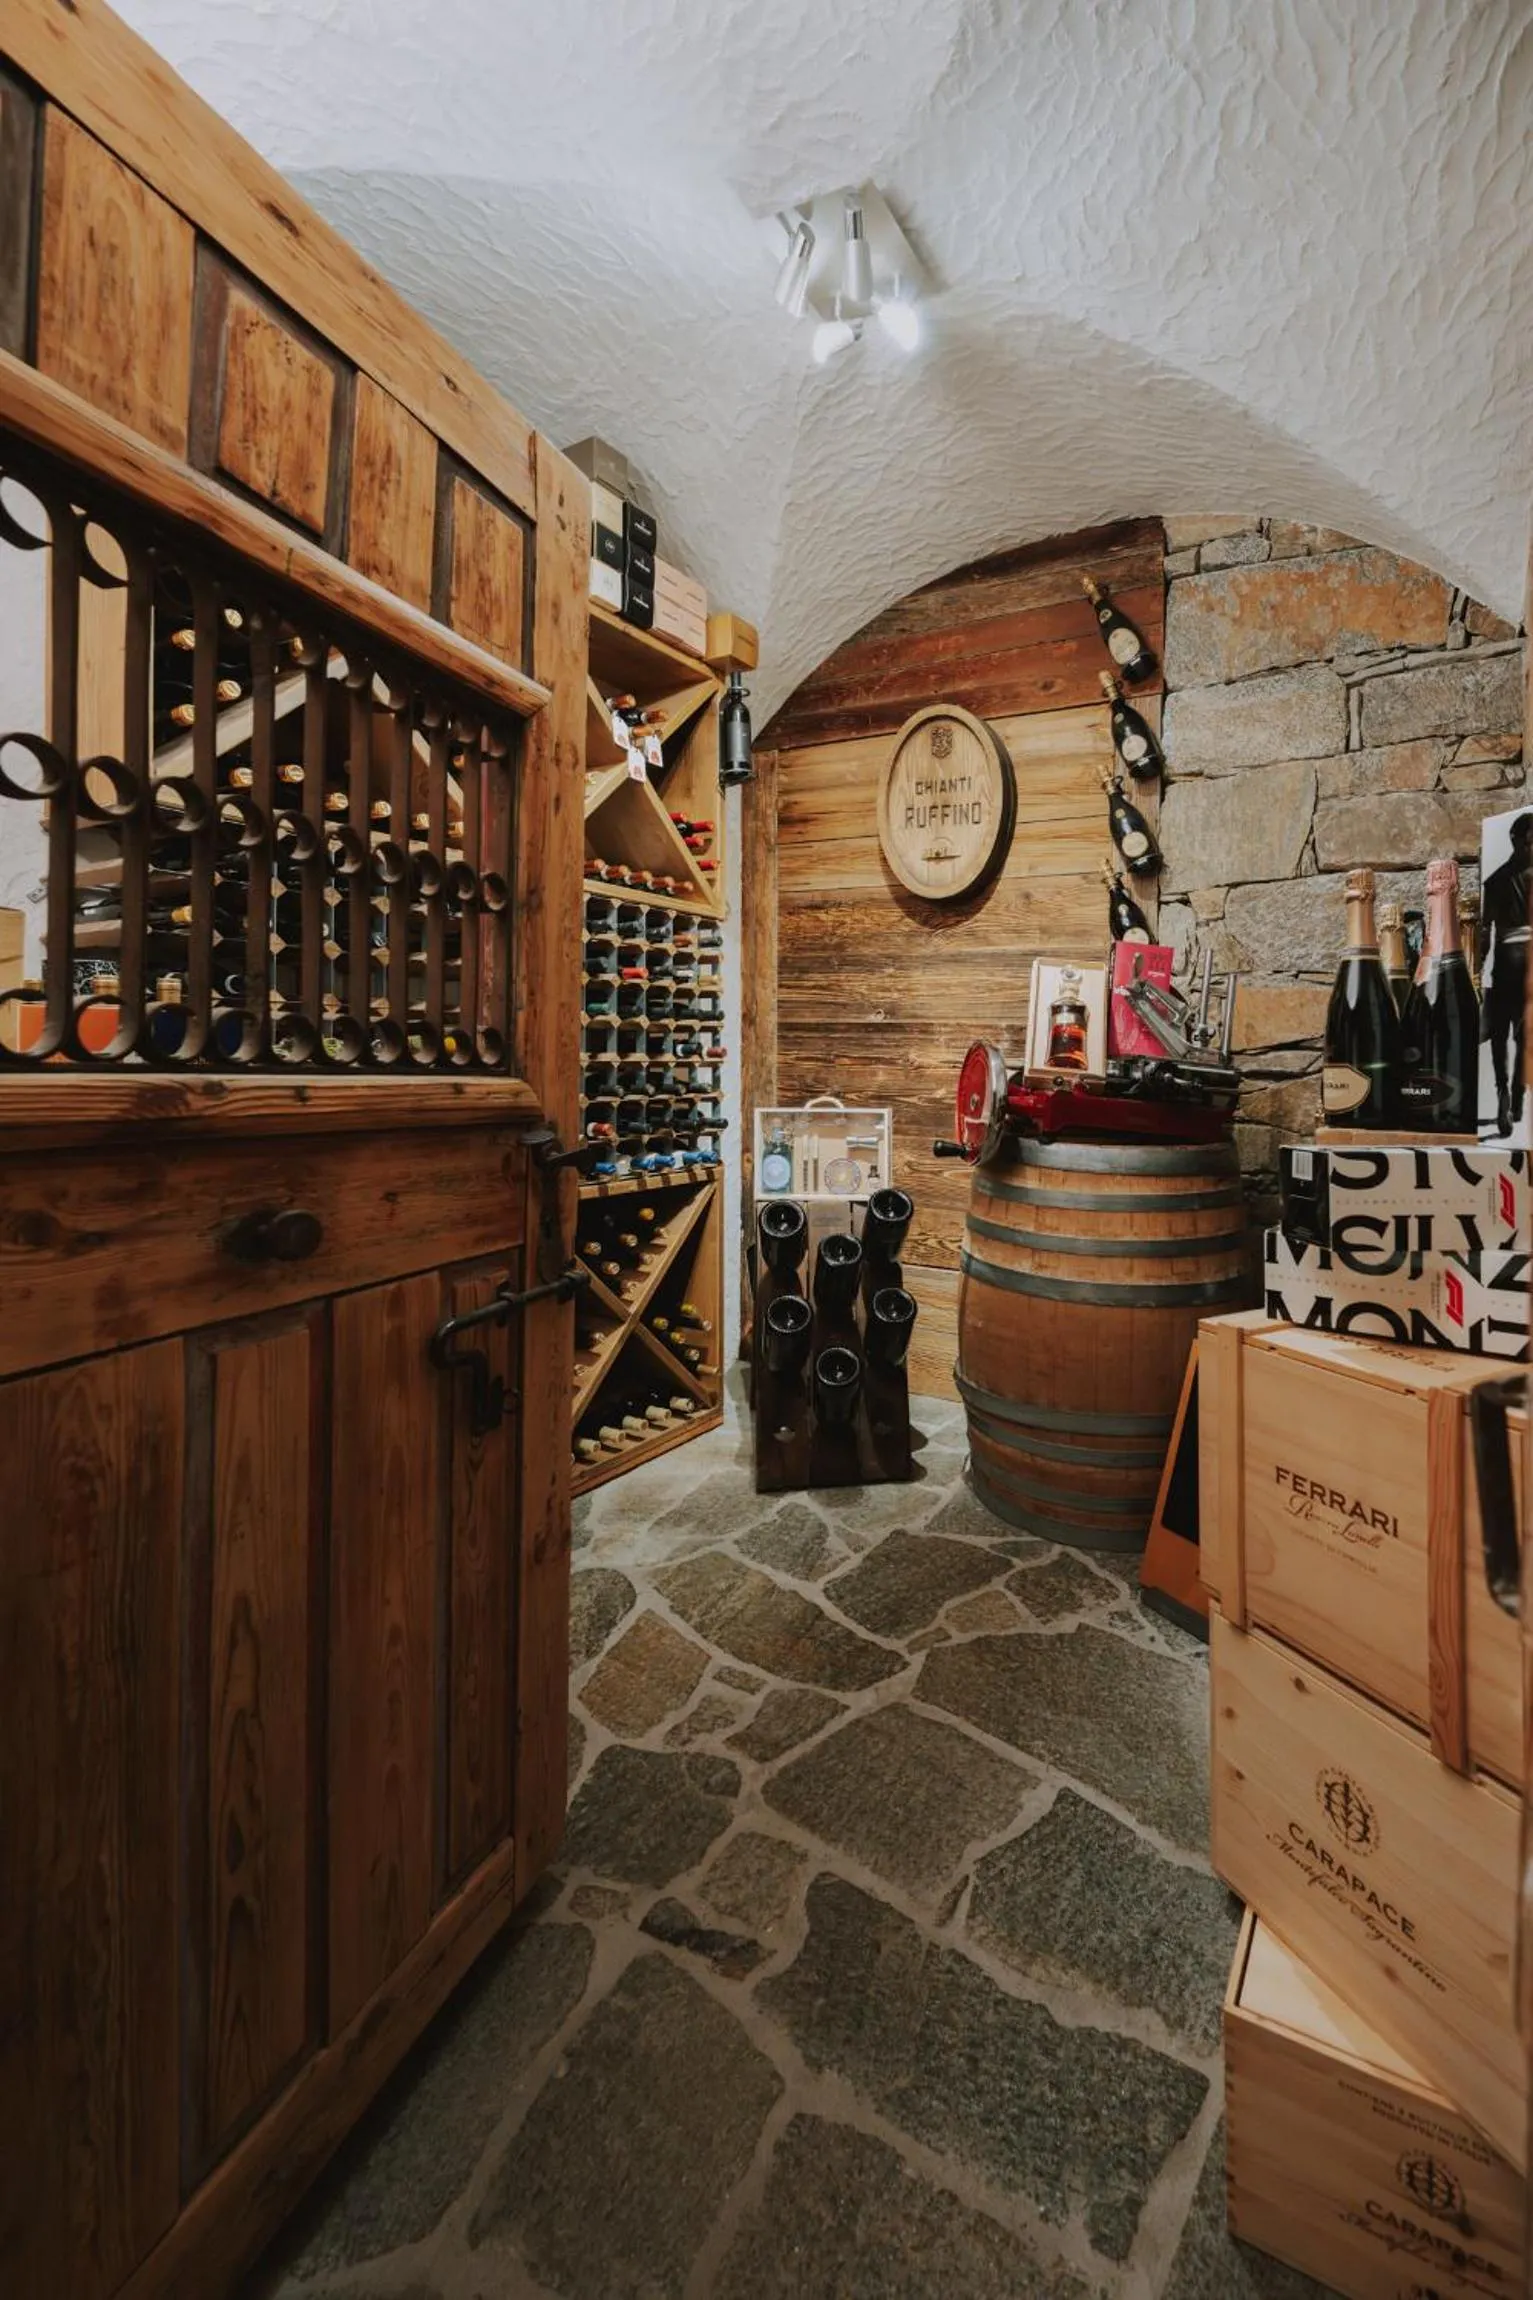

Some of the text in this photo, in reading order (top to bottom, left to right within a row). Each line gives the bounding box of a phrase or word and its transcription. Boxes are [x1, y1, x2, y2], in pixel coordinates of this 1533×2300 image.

[915, 777, 971, 795] CHIANTI
[906, 803, 981, 830] RUFFINO
[1275, 1465, 1399, 1539] FERRARI
[1289, 1822, 1417, 1941] CARAPACE
